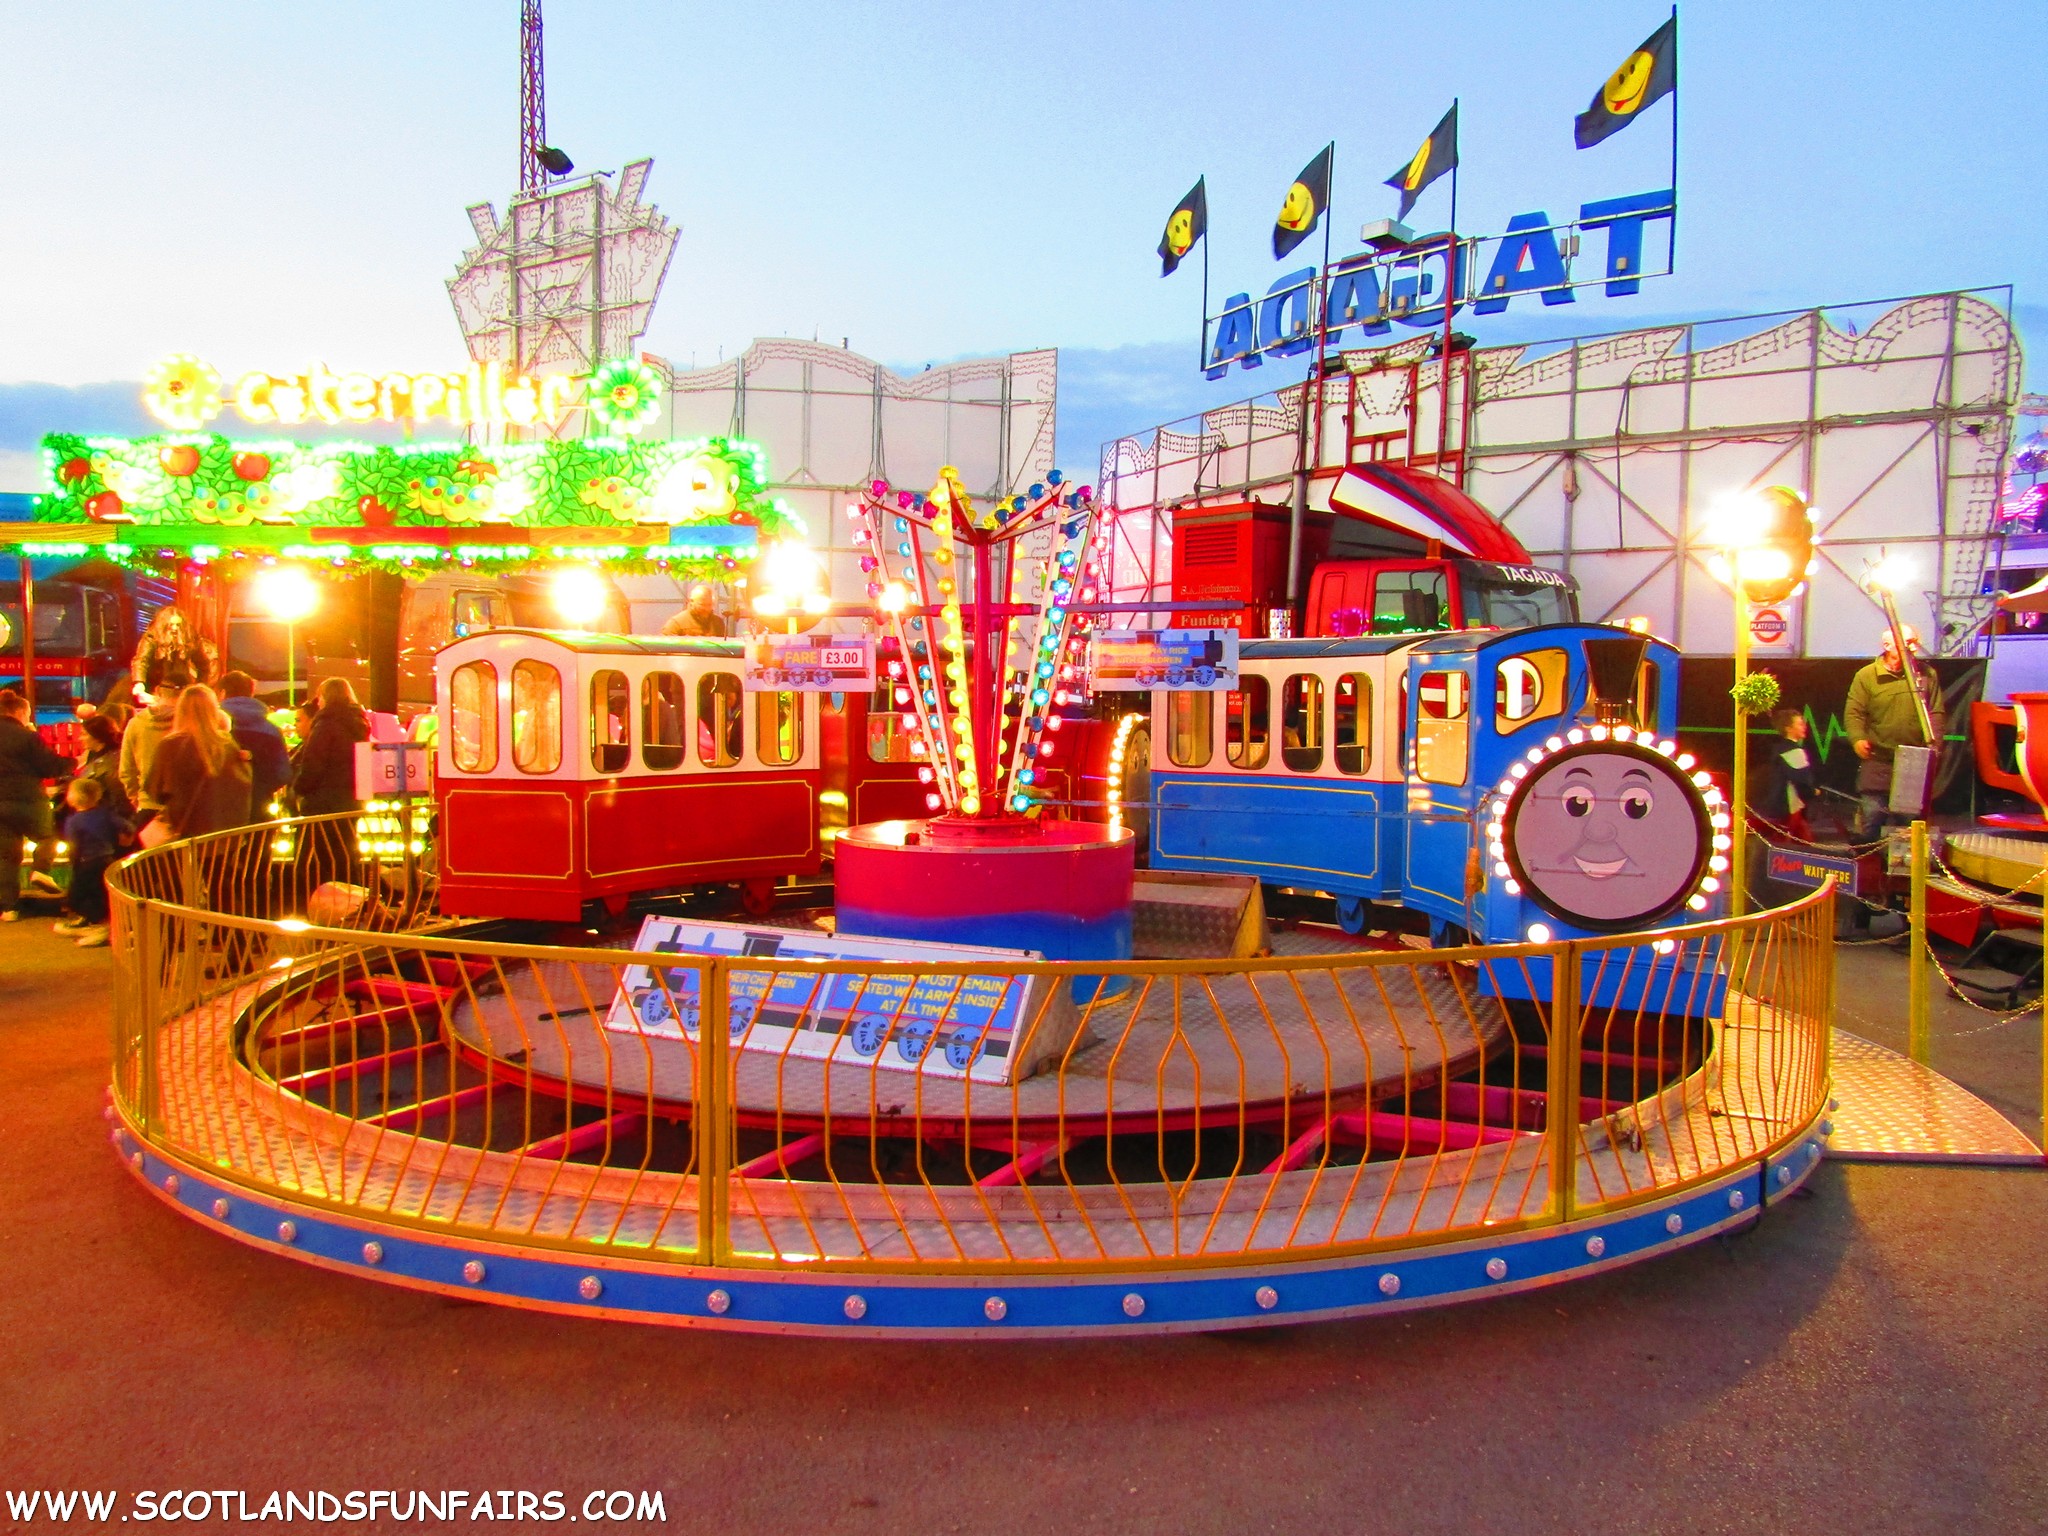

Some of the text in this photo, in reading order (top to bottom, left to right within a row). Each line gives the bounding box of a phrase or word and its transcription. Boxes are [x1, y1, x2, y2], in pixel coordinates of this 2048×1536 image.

[1496, 565, 1566, 587] TAGADA
[1751, 622, 1781, 630] PLATFORM
[785, 651, 858, 664] FARE £3.00
[1168, 646, 1189, 655] RIDE
[1136, 656, 1183, 664] CHILDREN
[385, 764, 416, 779] B9
[1804, 864, 1826, 879] WAIT
[750, 974, 797, 989] CHIREN
[916, 973, 955, 987] MUST
[746, 986, 774, 1000] TIMS
[894, 985, 925, 999] WH
[925, 989, 962, 1004] ARMS
[963, 993, 1007, 1011] INSIDE
[880, 1000, 898, 1012] AT
[898, 1001, 918, 1015] LL
